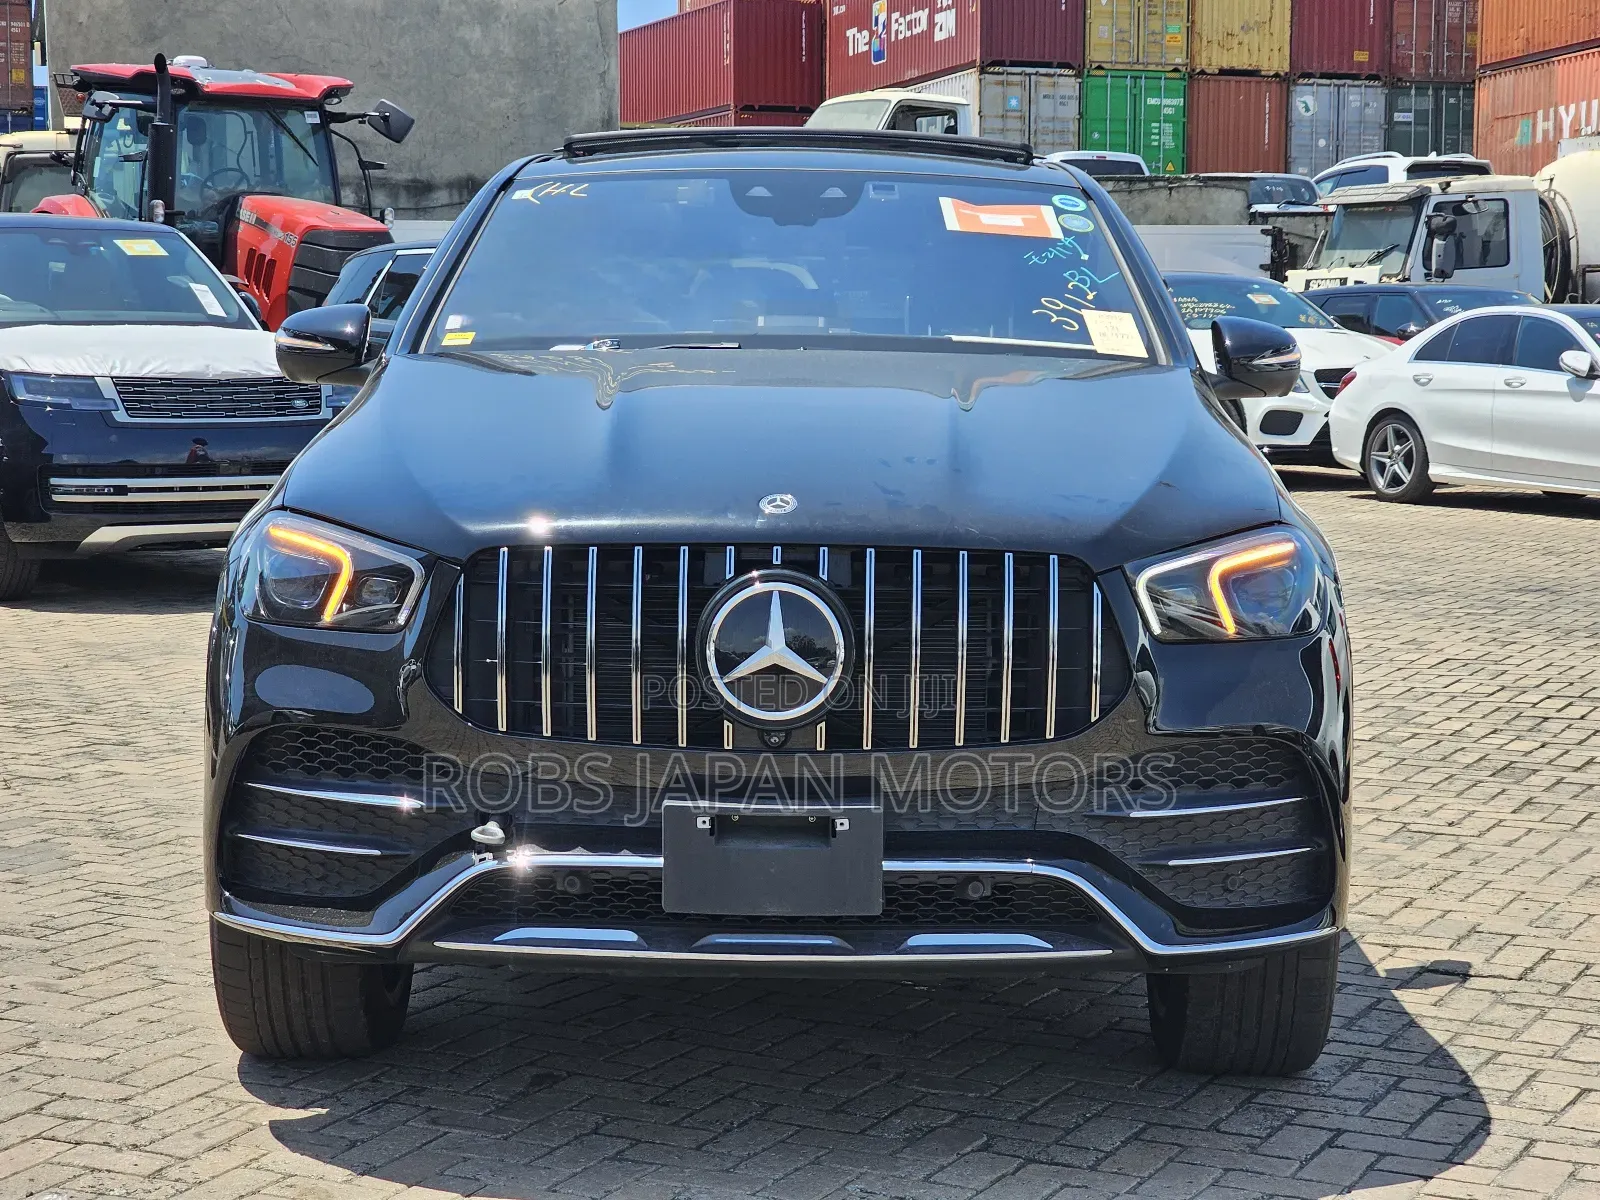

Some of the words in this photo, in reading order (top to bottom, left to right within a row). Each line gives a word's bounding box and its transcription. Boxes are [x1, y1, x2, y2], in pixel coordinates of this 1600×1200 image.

[846, 27, 869, 56] The
[891, 7, 929, 42] Factor
[934, 8, 956, 43] ZIM
[284, 231, 299, 248] 155
[1309, 279, 1341, 290] SCANIA
